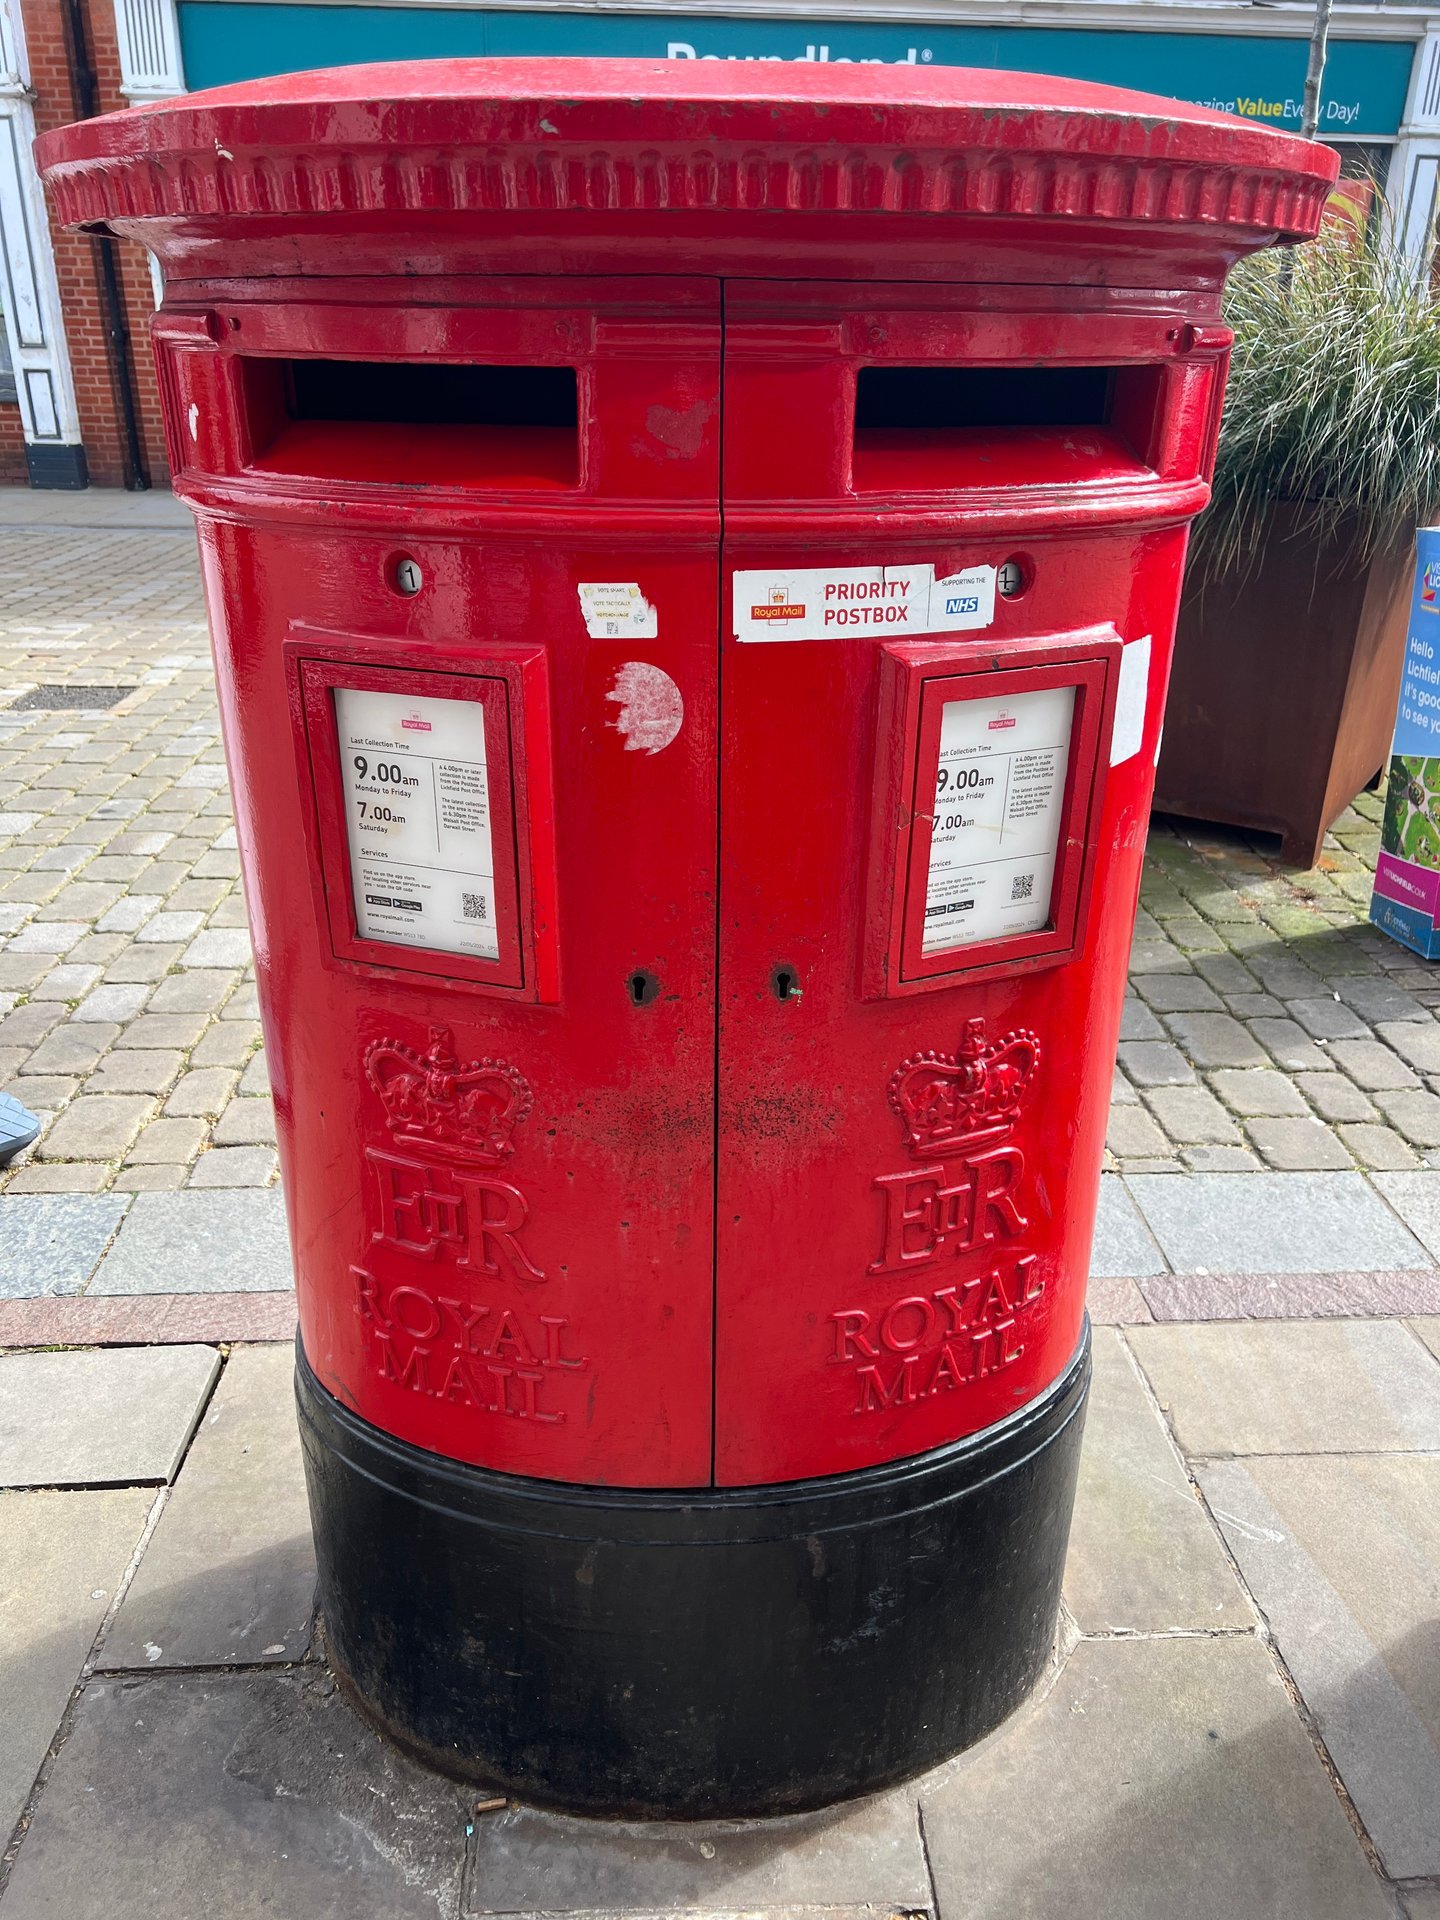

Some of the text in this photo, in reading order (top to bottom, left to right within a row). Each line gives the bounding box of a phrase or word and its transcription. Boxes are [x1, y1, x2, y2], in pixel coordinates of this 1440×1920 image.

[1237, 98, 1283, 117] Value
[1327, 101, 1360, 125] Day!
[942, 578, 975, 587] SUPPORTING
[825, 581, 911, 601] PRIORITY
[754, 605, 804, 618] Royal Mail
[947, 598, 977, 613] NHS
[824, 606, 909, 626] POSTBOX
[1410, 637, 1434, 659] Hello
[1402, 703, 1429, 728] to see
[350, 736, 410, 751] Last Collection Time
[950, 746, 977, 757] Collection
[354, 756, 419, 787] 9.00am
[937, 768, 994, 793] 9.00am
[355, 784, 380, 795] Monday
[391, 788, 412, 799] Friday
[966, 791, 985, 800] Friday
[357, 801, 406, 823] 7.00am
[358, 823, 388, 834] Saturday
[931, 815, 975, 831] 7.00am
[932, 835, 956, 843] aturday
[361, 848, 388, 858] Services
[928, 859, 951, 868] ervices
[367, 912, 415, 923] www.royalmail.com
[350, 1263, 590, 1372] ROYAL
[826, 1254, 1046, 1366] ROYAL
[851, 1318, 1026, 1413] MAIL
[374, 1329, 568, 1424] MAIL
